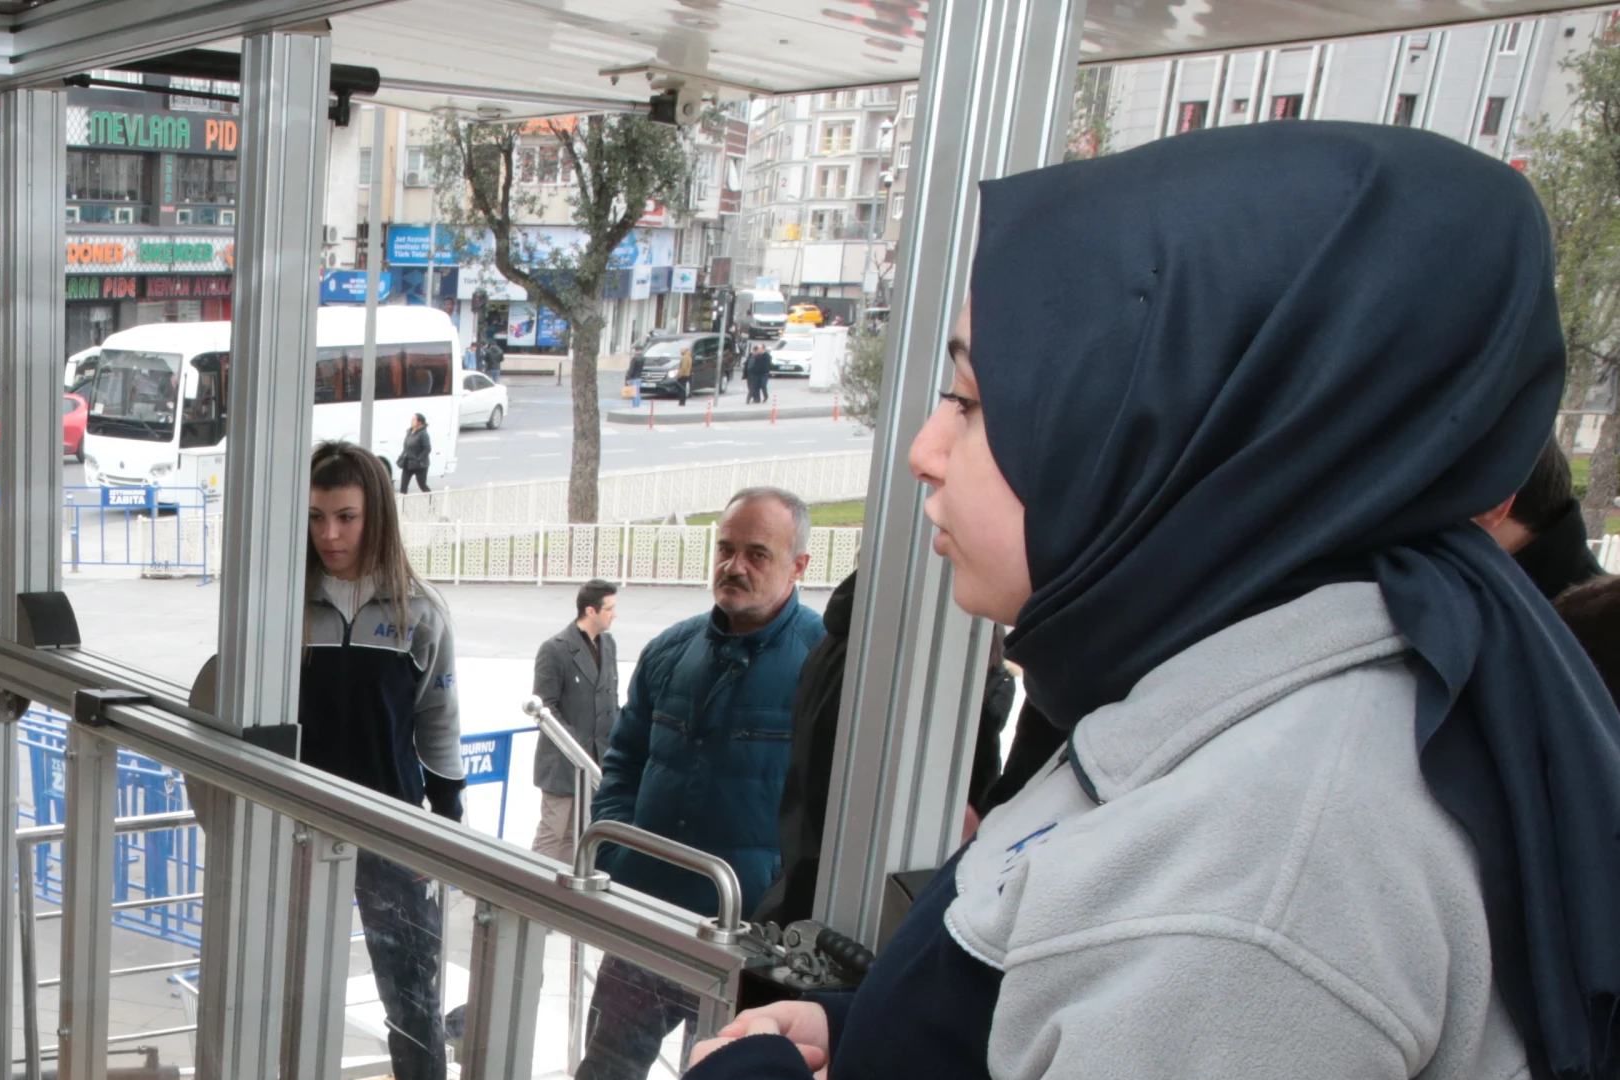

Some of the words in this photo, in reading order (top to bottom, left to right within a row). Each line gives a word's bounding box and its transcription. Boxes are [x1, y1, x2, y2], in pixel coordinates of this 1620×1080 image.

[90, 111, 191, 149] MEVLANA
[781, 177, 788, 188] 2
[394, 250, 410, 258] Türk
[65, 277, 99, 299] ANA
[109, 495, 146, 505] ZABITA
[434, 674, 454, 689] AF
[460, 740, 496, 756] BURNU
